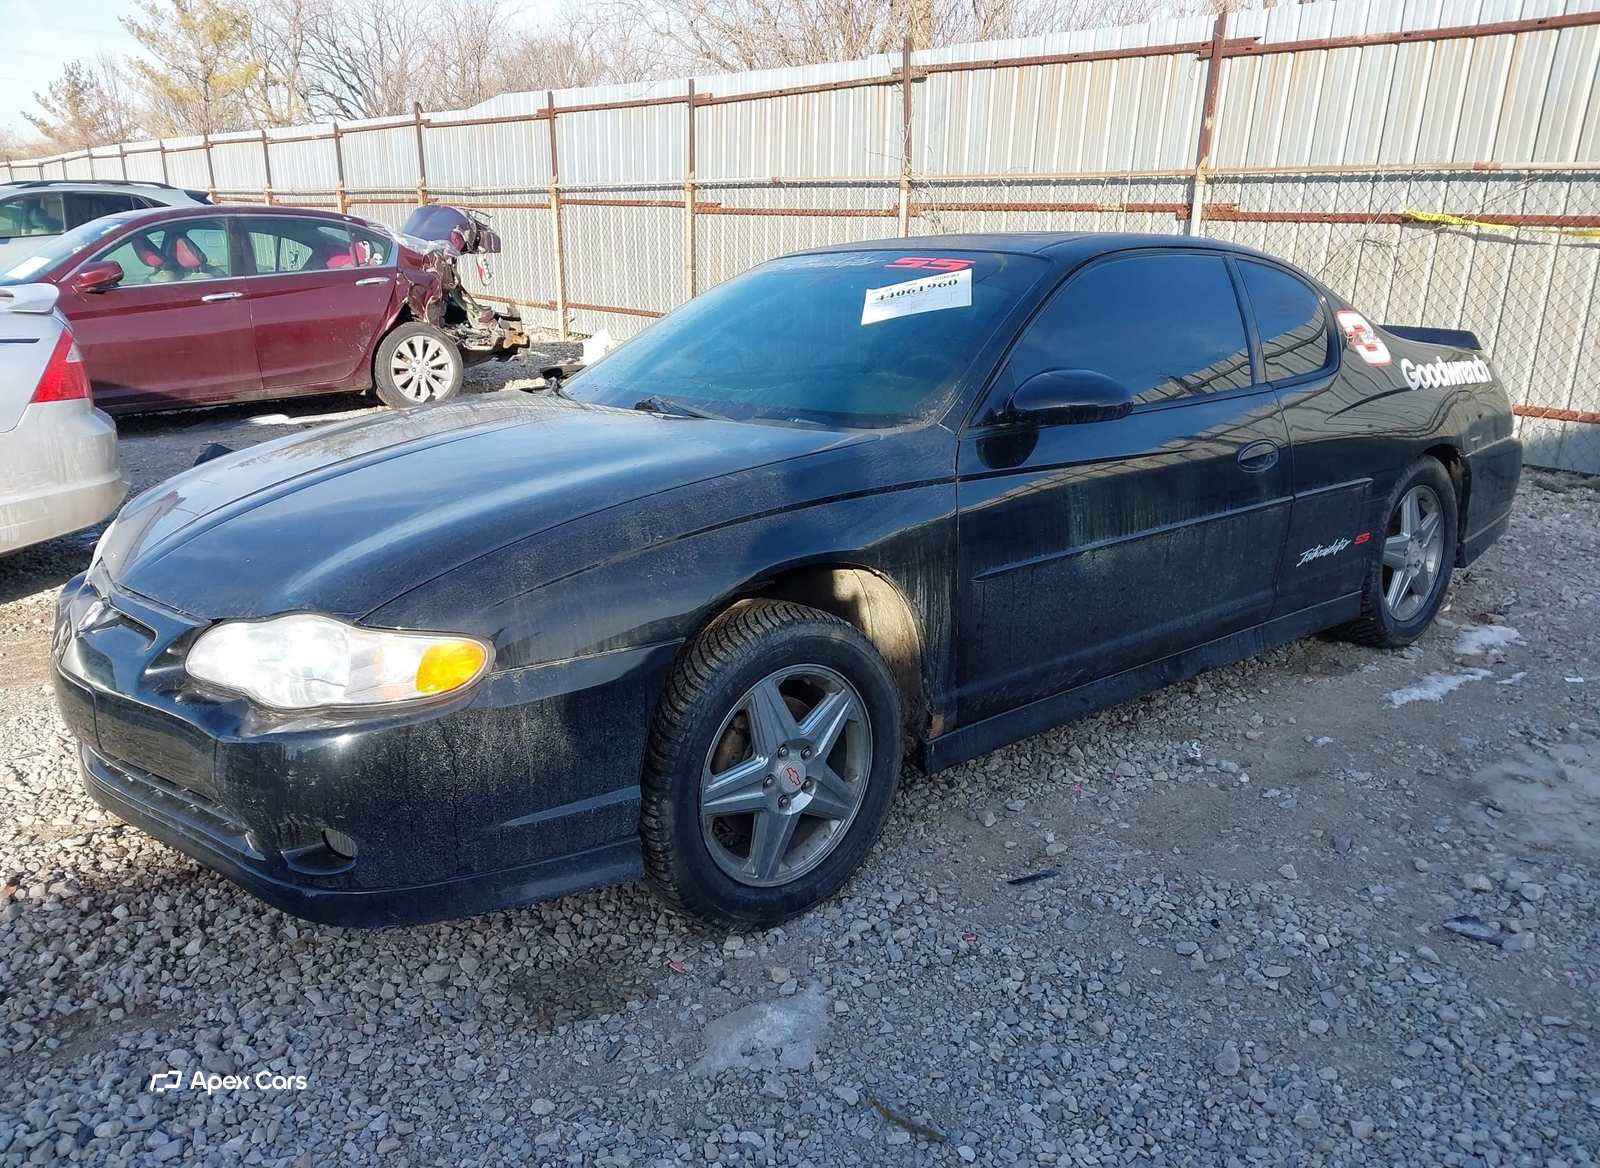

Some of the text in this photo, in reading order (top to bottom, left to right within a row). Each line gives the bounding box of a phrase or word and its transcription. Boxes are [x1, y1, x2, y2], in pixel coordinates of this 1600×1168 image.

[884, 257, 976, 272] SS
[875, 278, 958, 301] 44061960
[1336, 309, 1393, 367] 3
[1400, 354, 1493, 391] Goodwrench
[1353, 532, 1371, 545] SS
